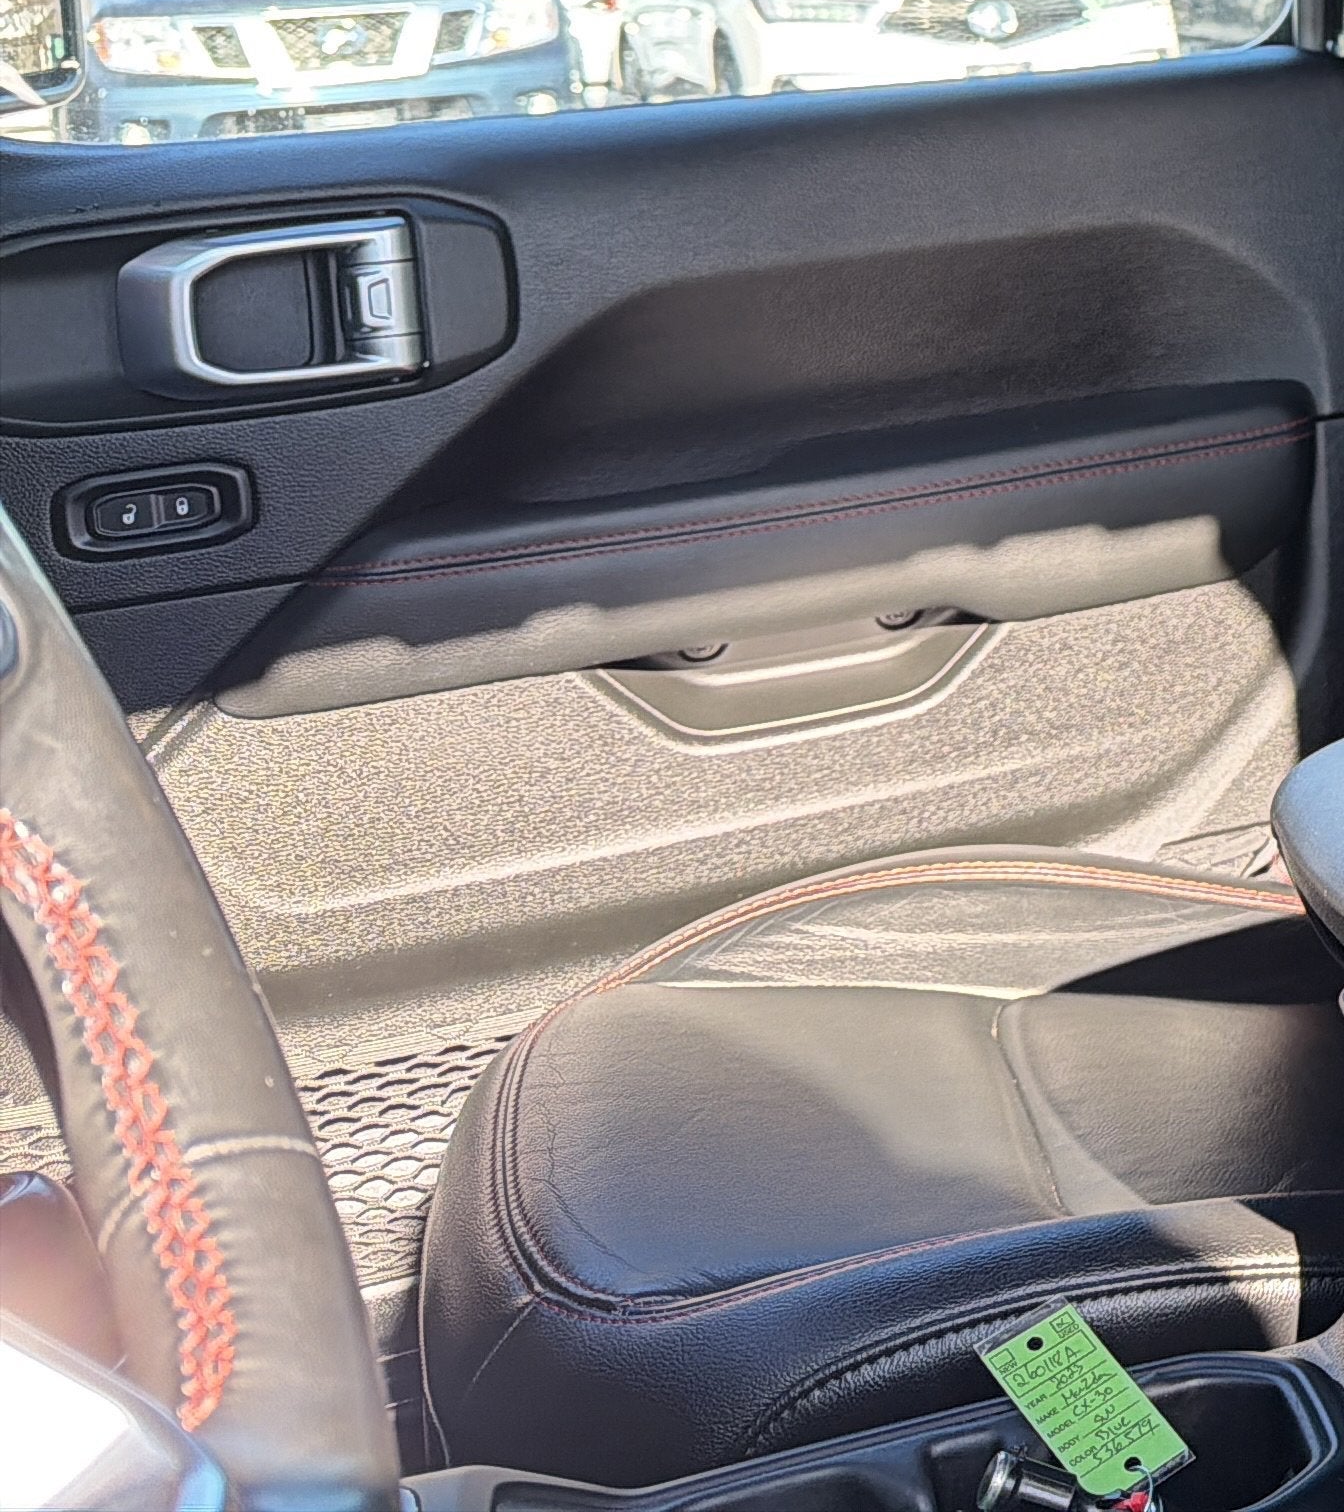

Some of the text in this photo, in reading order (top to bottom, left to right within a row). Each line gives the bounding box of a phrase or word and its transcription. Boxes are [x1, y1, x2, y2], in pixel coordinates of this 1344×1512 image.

[1058, 1323, 1080, 1338] USED
[999, 1360, 1018, 1375] NEW
[1024, 1393, 1048, 1410] YEAR
[1036, 1408, 1060, 1425] MAKE
[1047, 1419, 1076, 1439] MODEL
[1057, 1435, 1081, 1453] BODY
[1069, 1445, 1098, 1467] COLOR
